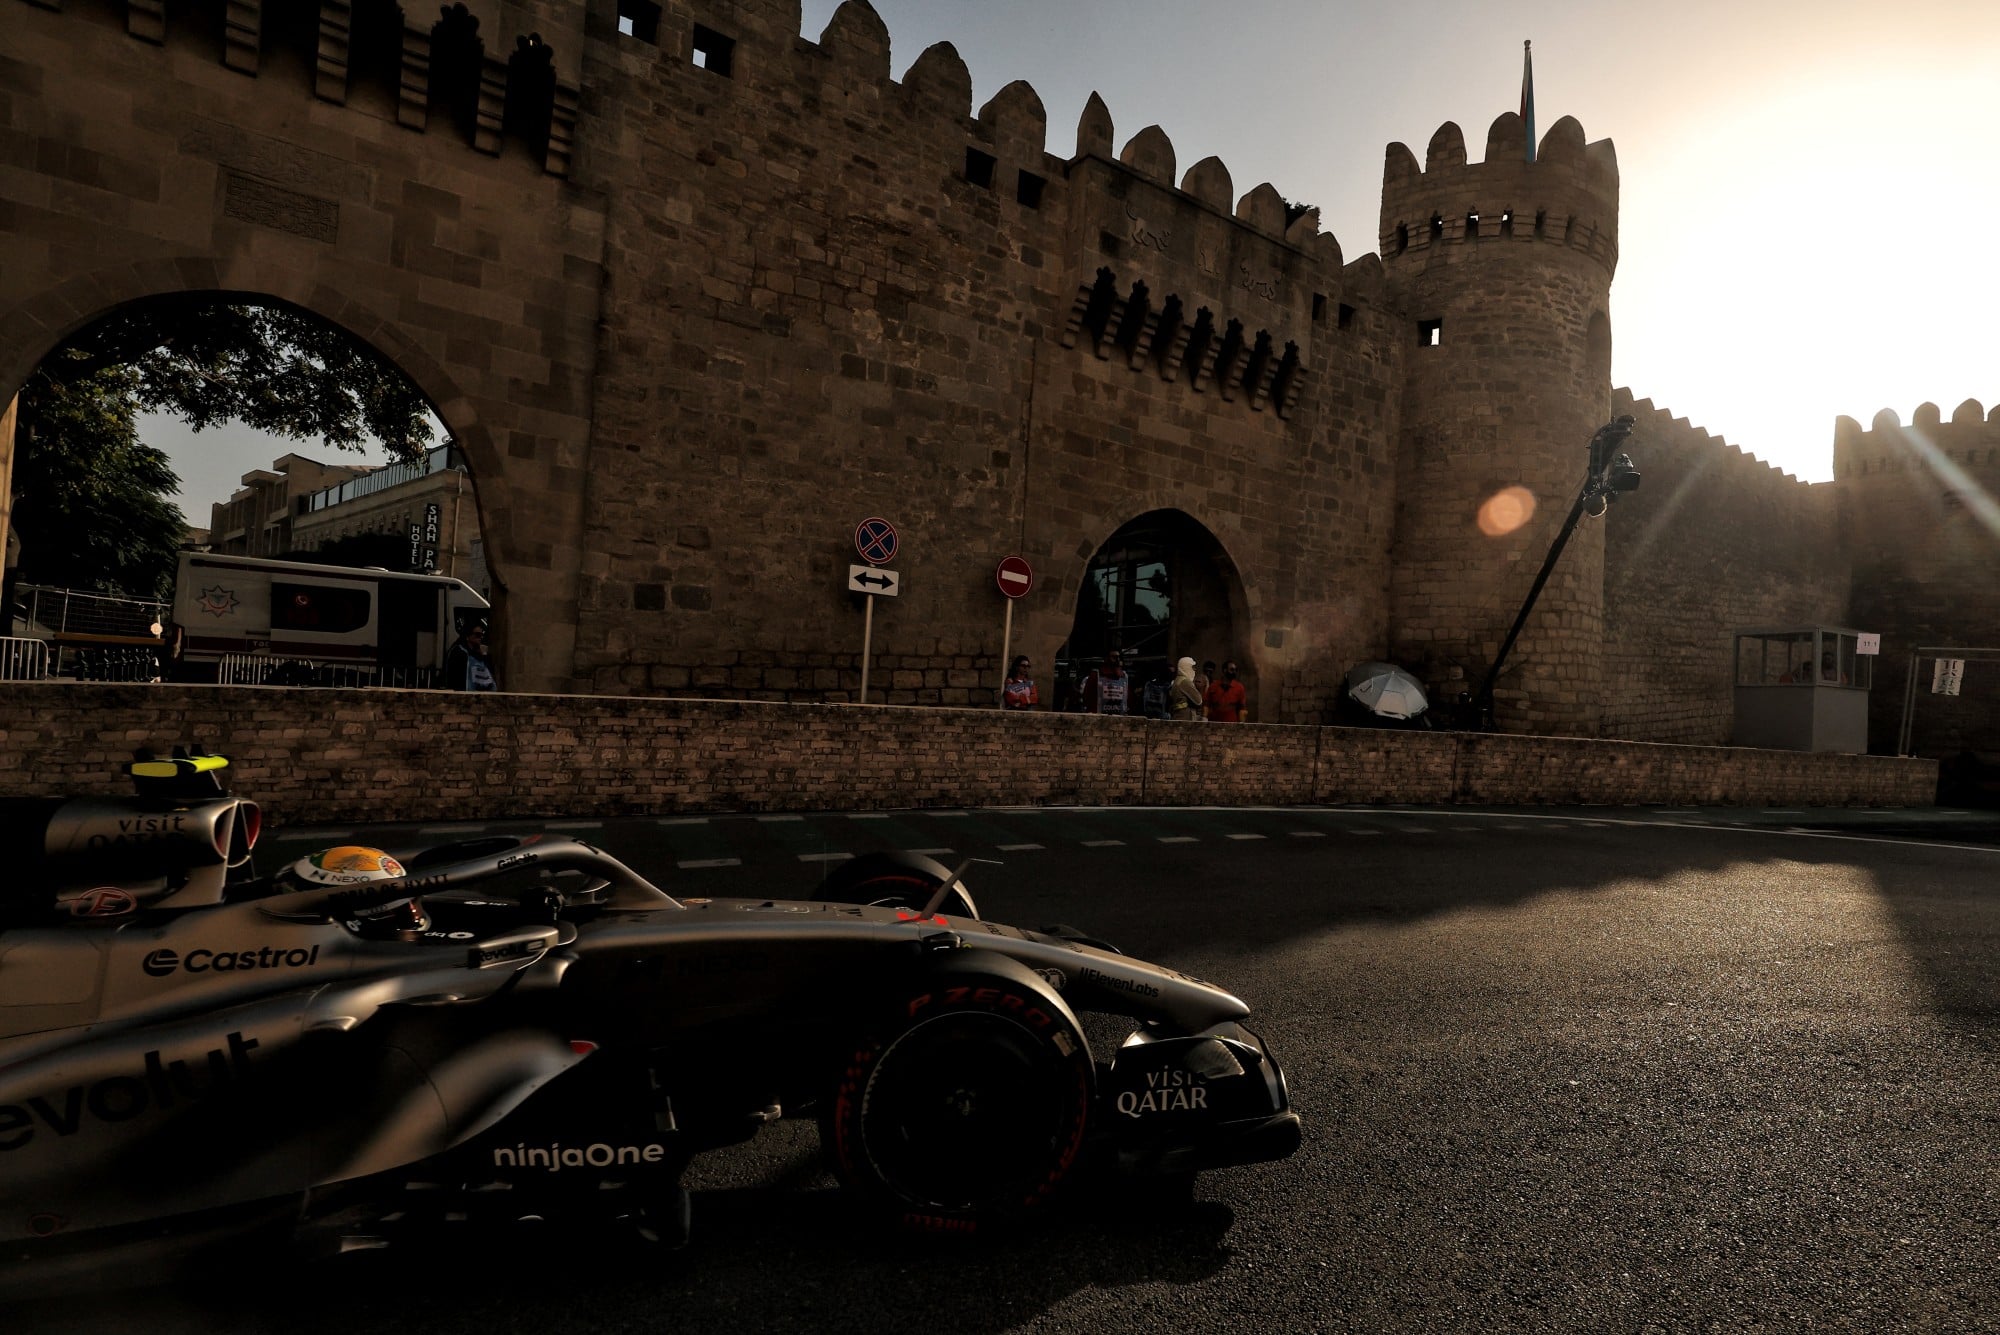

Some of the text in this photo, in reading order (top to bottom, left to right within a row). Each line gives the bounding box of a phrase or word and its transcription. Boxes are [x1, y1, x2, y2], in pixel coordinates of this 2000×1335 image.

[426, 505, 438, 542] SHAH
[411, 525, 421, 565] HOTEL
[119, 814, 186, 832] visit
[331, 874, 370, 883] NEXO
[183, 944, 320, 973] Castrol
[942, 985, 1053, 1030] ZERO
[1117, 1087, 1208, 1119] QATAR
[494, 1142, 665, 1173] ninjaOne
